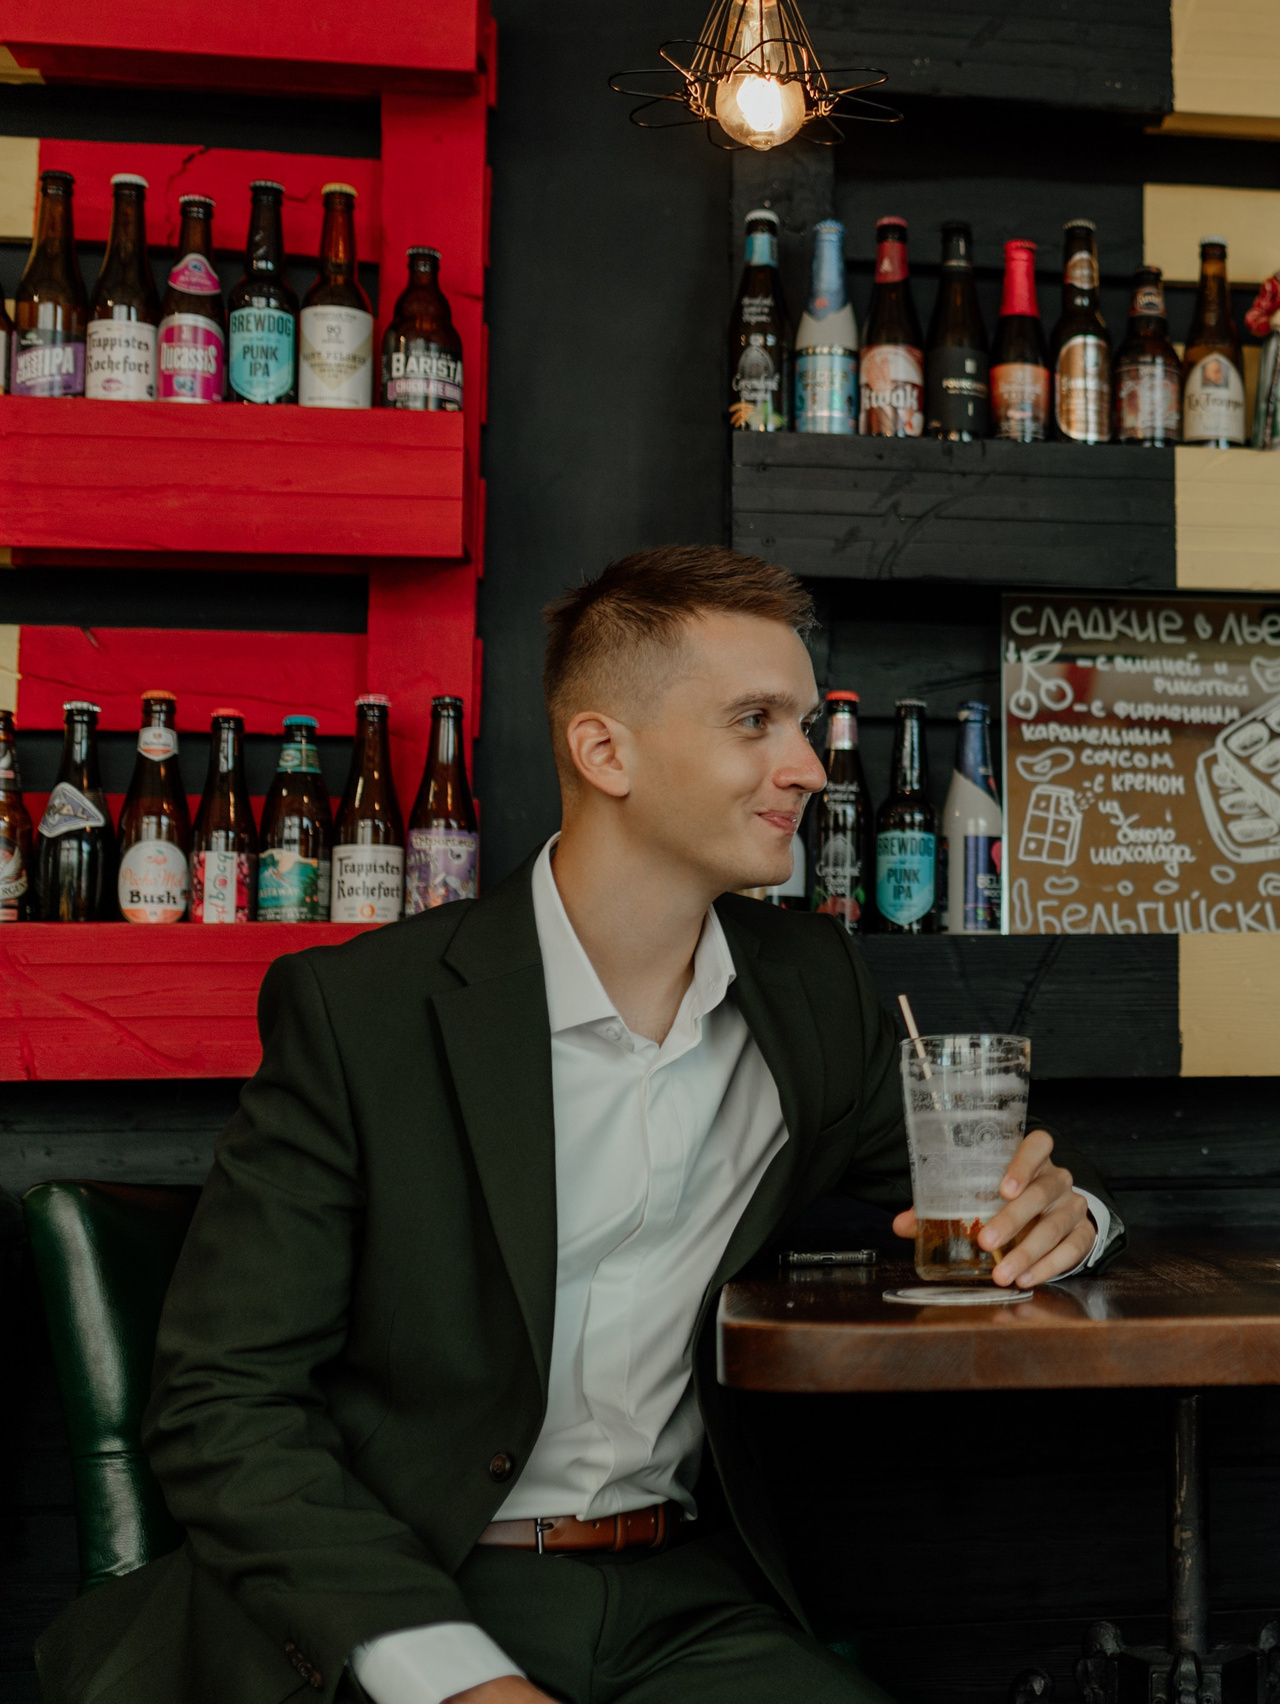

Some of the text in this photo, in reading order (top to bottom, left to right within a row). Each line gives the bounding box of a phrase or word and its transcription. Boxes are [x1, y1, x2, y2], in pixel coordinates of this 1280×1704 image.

[231, 312, 292, 335] BREWDOG
[43, 346, 75, 375] IPA
[242, 345, 278, 361] PUNK
[250, 362, 270, 377] IPA
[391, 351, 463, 386] BARISTA
[1010, 605, 1187, 644] СЛАДКИЕ
[877, 837, 934, 857] BREWDOG
[338, 855, 400, 877] Trappistes
[887, 868, 920, 885] PUNK
[129, 890, 177, 905] Bush
[337, 880, 400, 900] Rochefort
[893, 885, 912, 900] IPA
